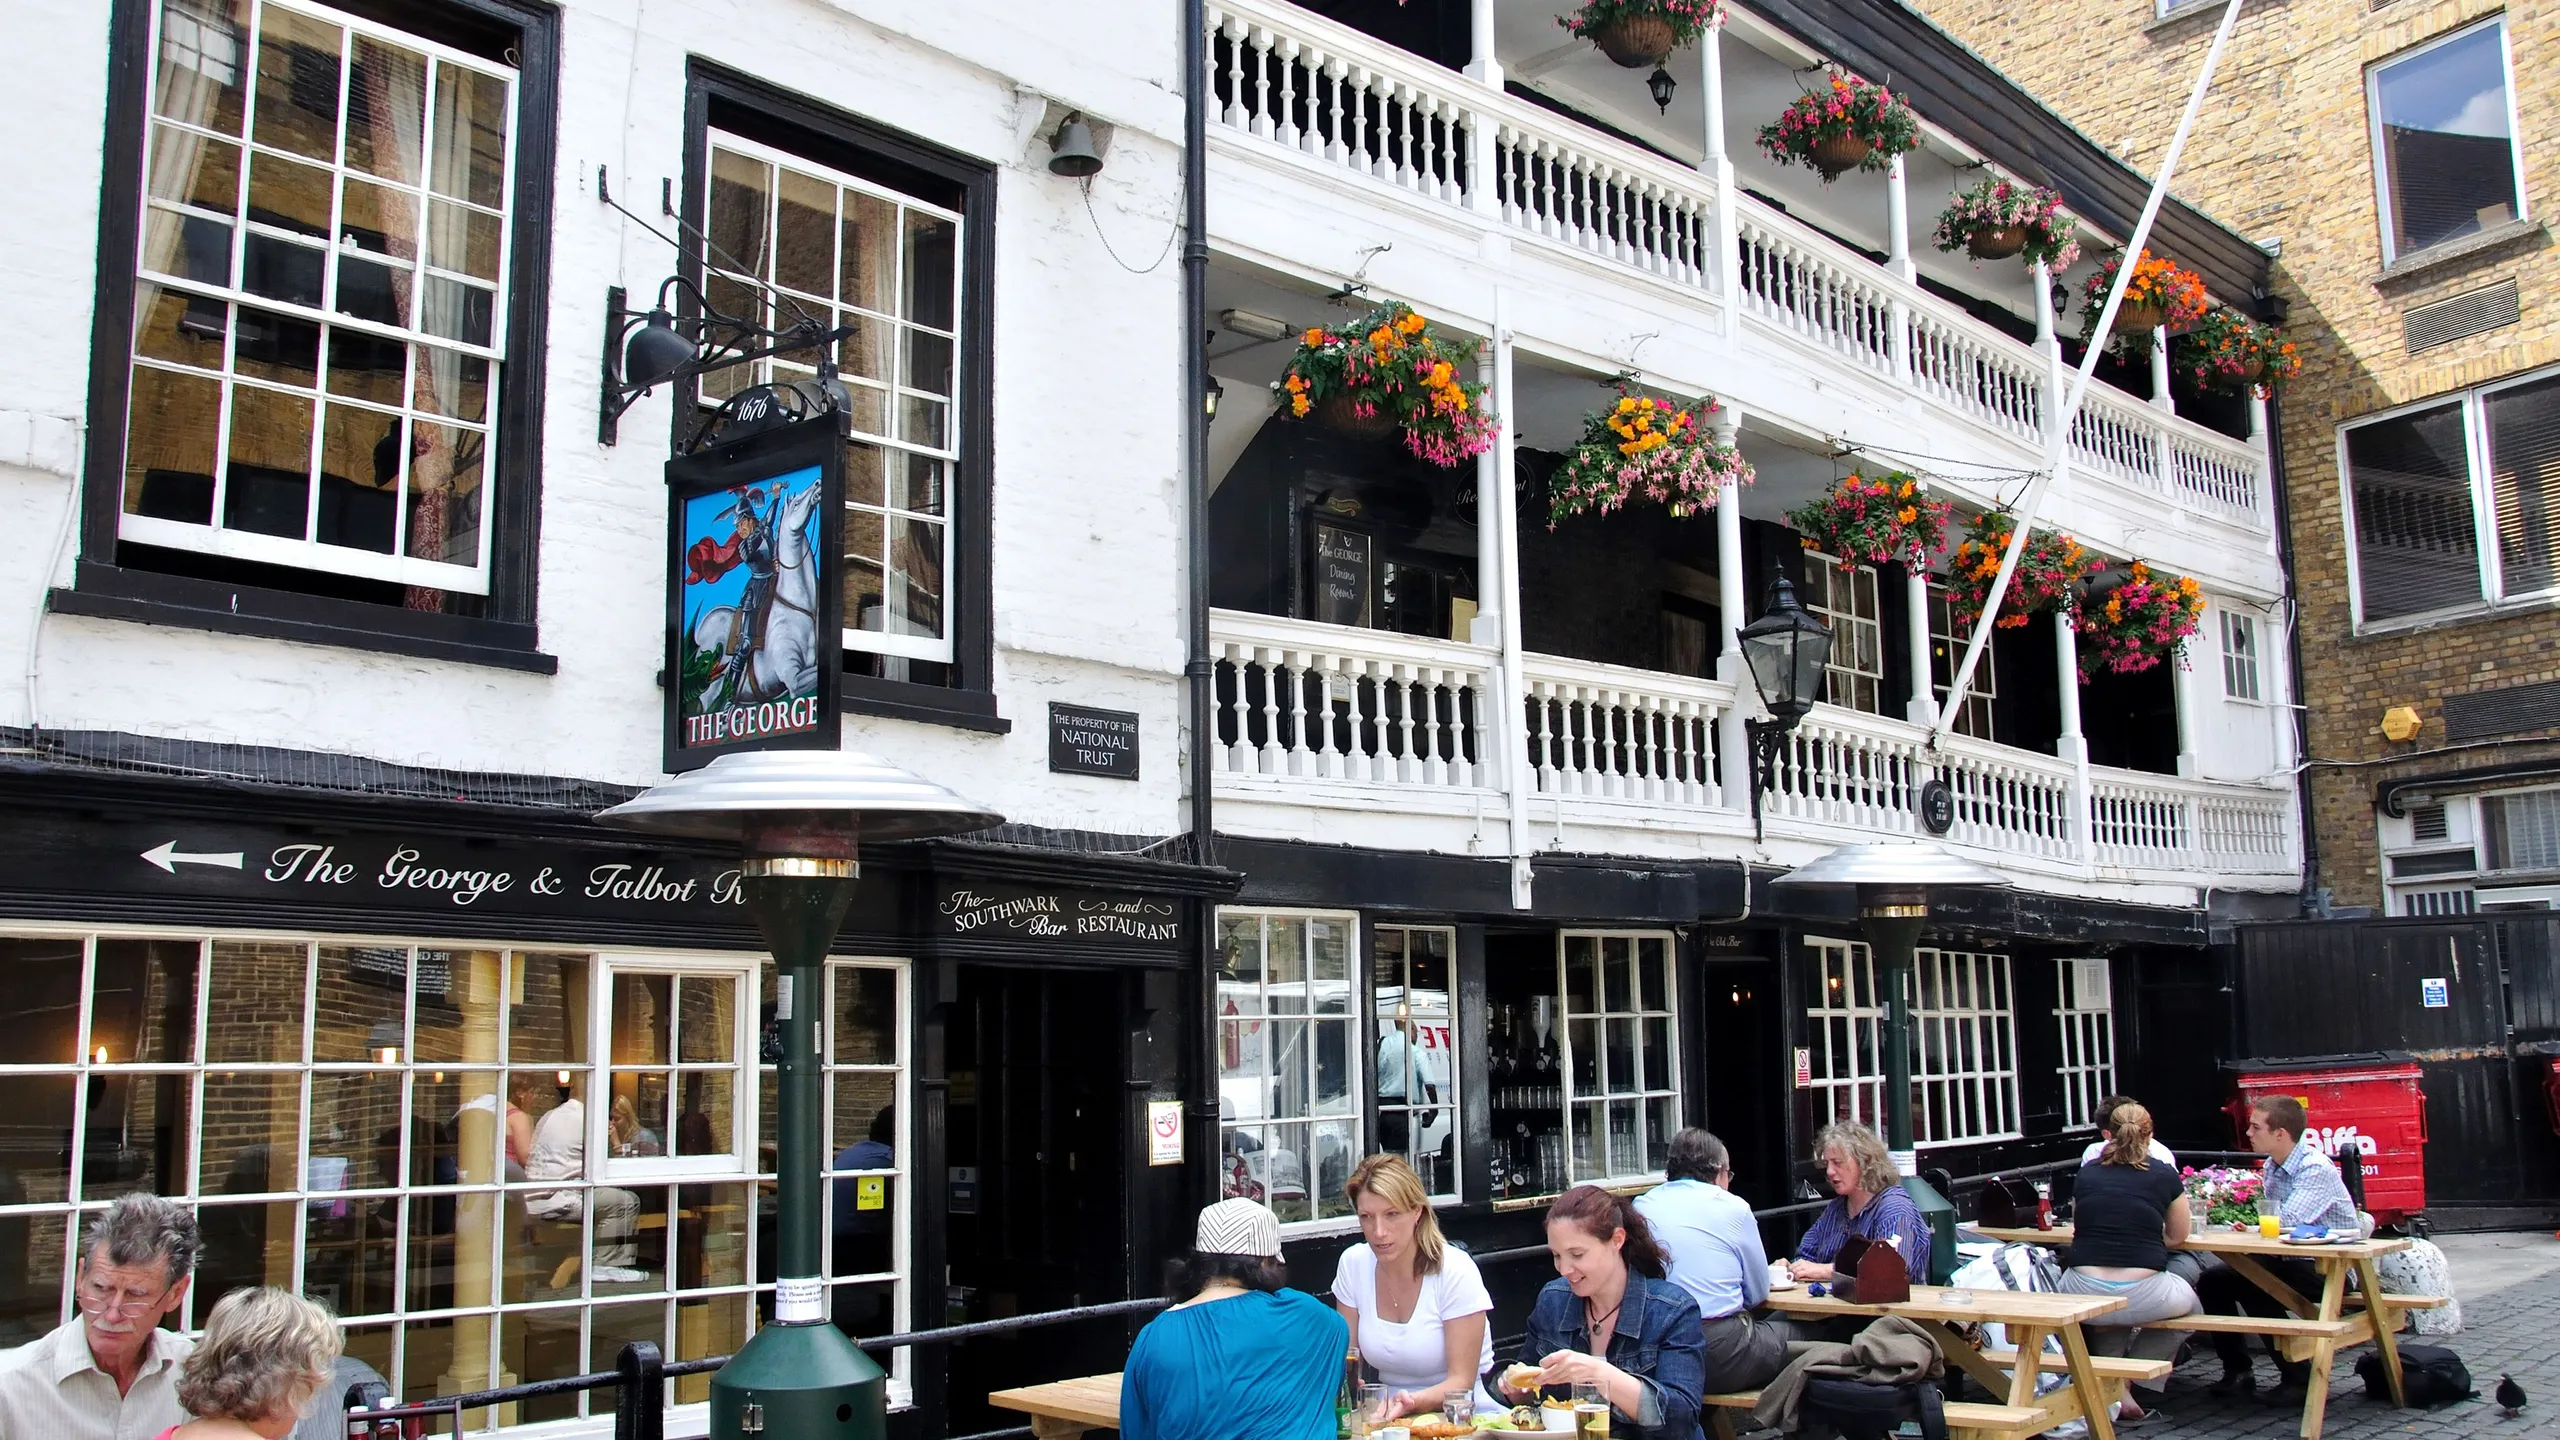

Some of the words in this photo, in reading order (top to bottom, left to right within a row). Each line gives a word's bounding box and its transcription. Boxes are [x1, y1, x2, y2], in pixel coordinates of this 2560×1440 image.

[737, 395, 769, 422] 1676
[1334, 547, 1363, 563] GEORGE
[1329, 563, 1355, 586] Dining
[688, 711, 724, 743] THE
[730, 695, 818, 737] GEORGE
[1054, 714, 1070, 725] THE
[1071, 716, 1109, 730] PROPERTY
[1110, 721, 1120, 731] OF
[1121, 723, 1136, 733] THE
[1061, 729, 1129, 750] NATIONAL
[1076, 749, 1115, 766] TRUST
[264, 843, 358, 883] The
[378, 843, 516, 905] George
[530, 867, 565, 896] &
[584, 864, 698, 902] Talbot
[940, 891, 994, 915] The
[955, 896, 1060, 932] SOUTHWARK
[1111, 898, 1144, 914] and
[1013, 914, 1069, 936] Bar
[1078, 915, 1178, 940] RESTAURANT
[2300, 1125, 2377, 1156] Biffa
